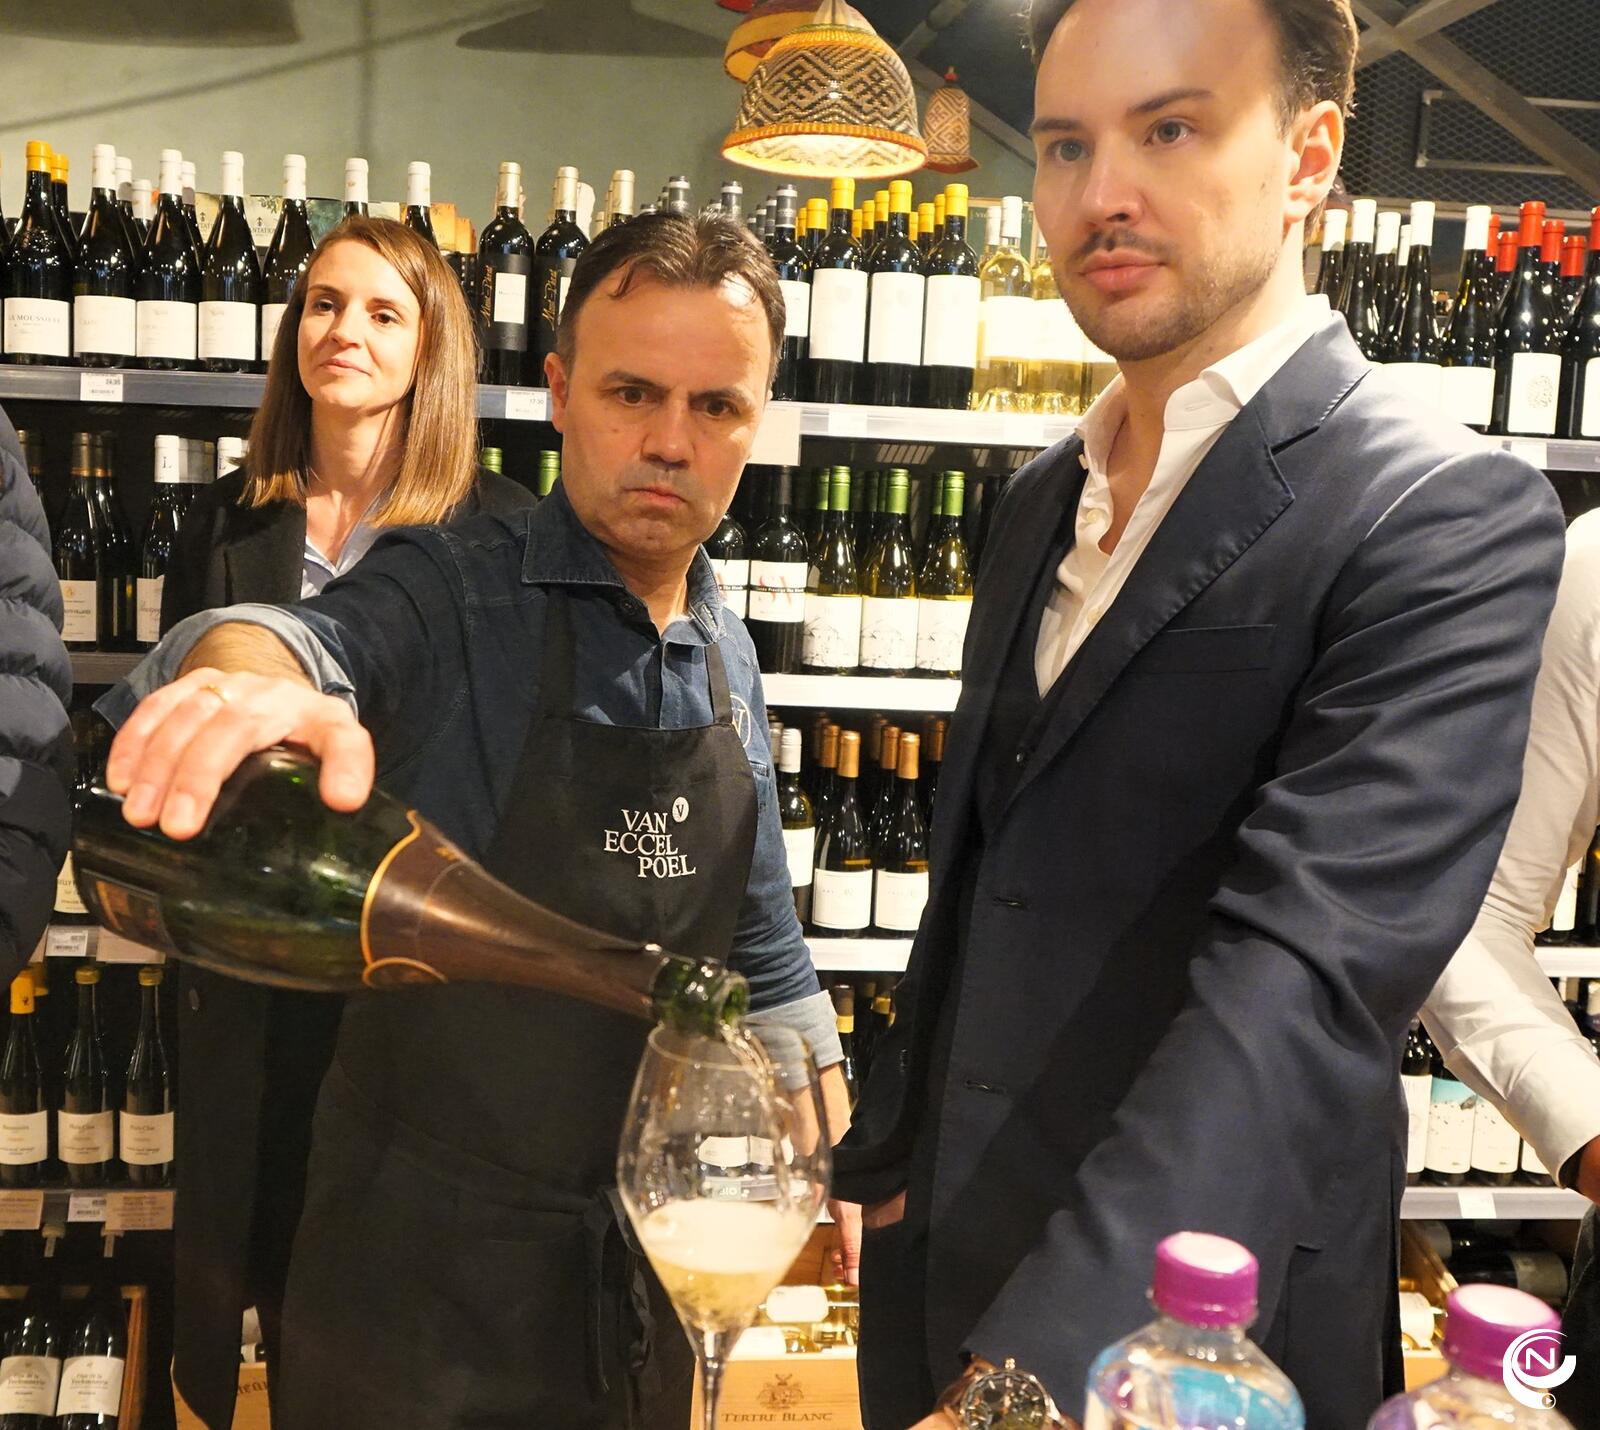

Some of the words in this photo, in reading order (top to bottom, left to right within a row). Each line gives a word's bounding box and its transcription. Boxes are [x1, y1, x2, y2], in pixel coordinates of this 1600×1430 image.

[621, 809, 668, 834] VAN
[604, 829, 679, 856] ECCEL
[637, 854, 697, 879] POEL
[721, 1413, 776, 1422] TERTRE
[782, 1412, 833, 1422] BLANC
